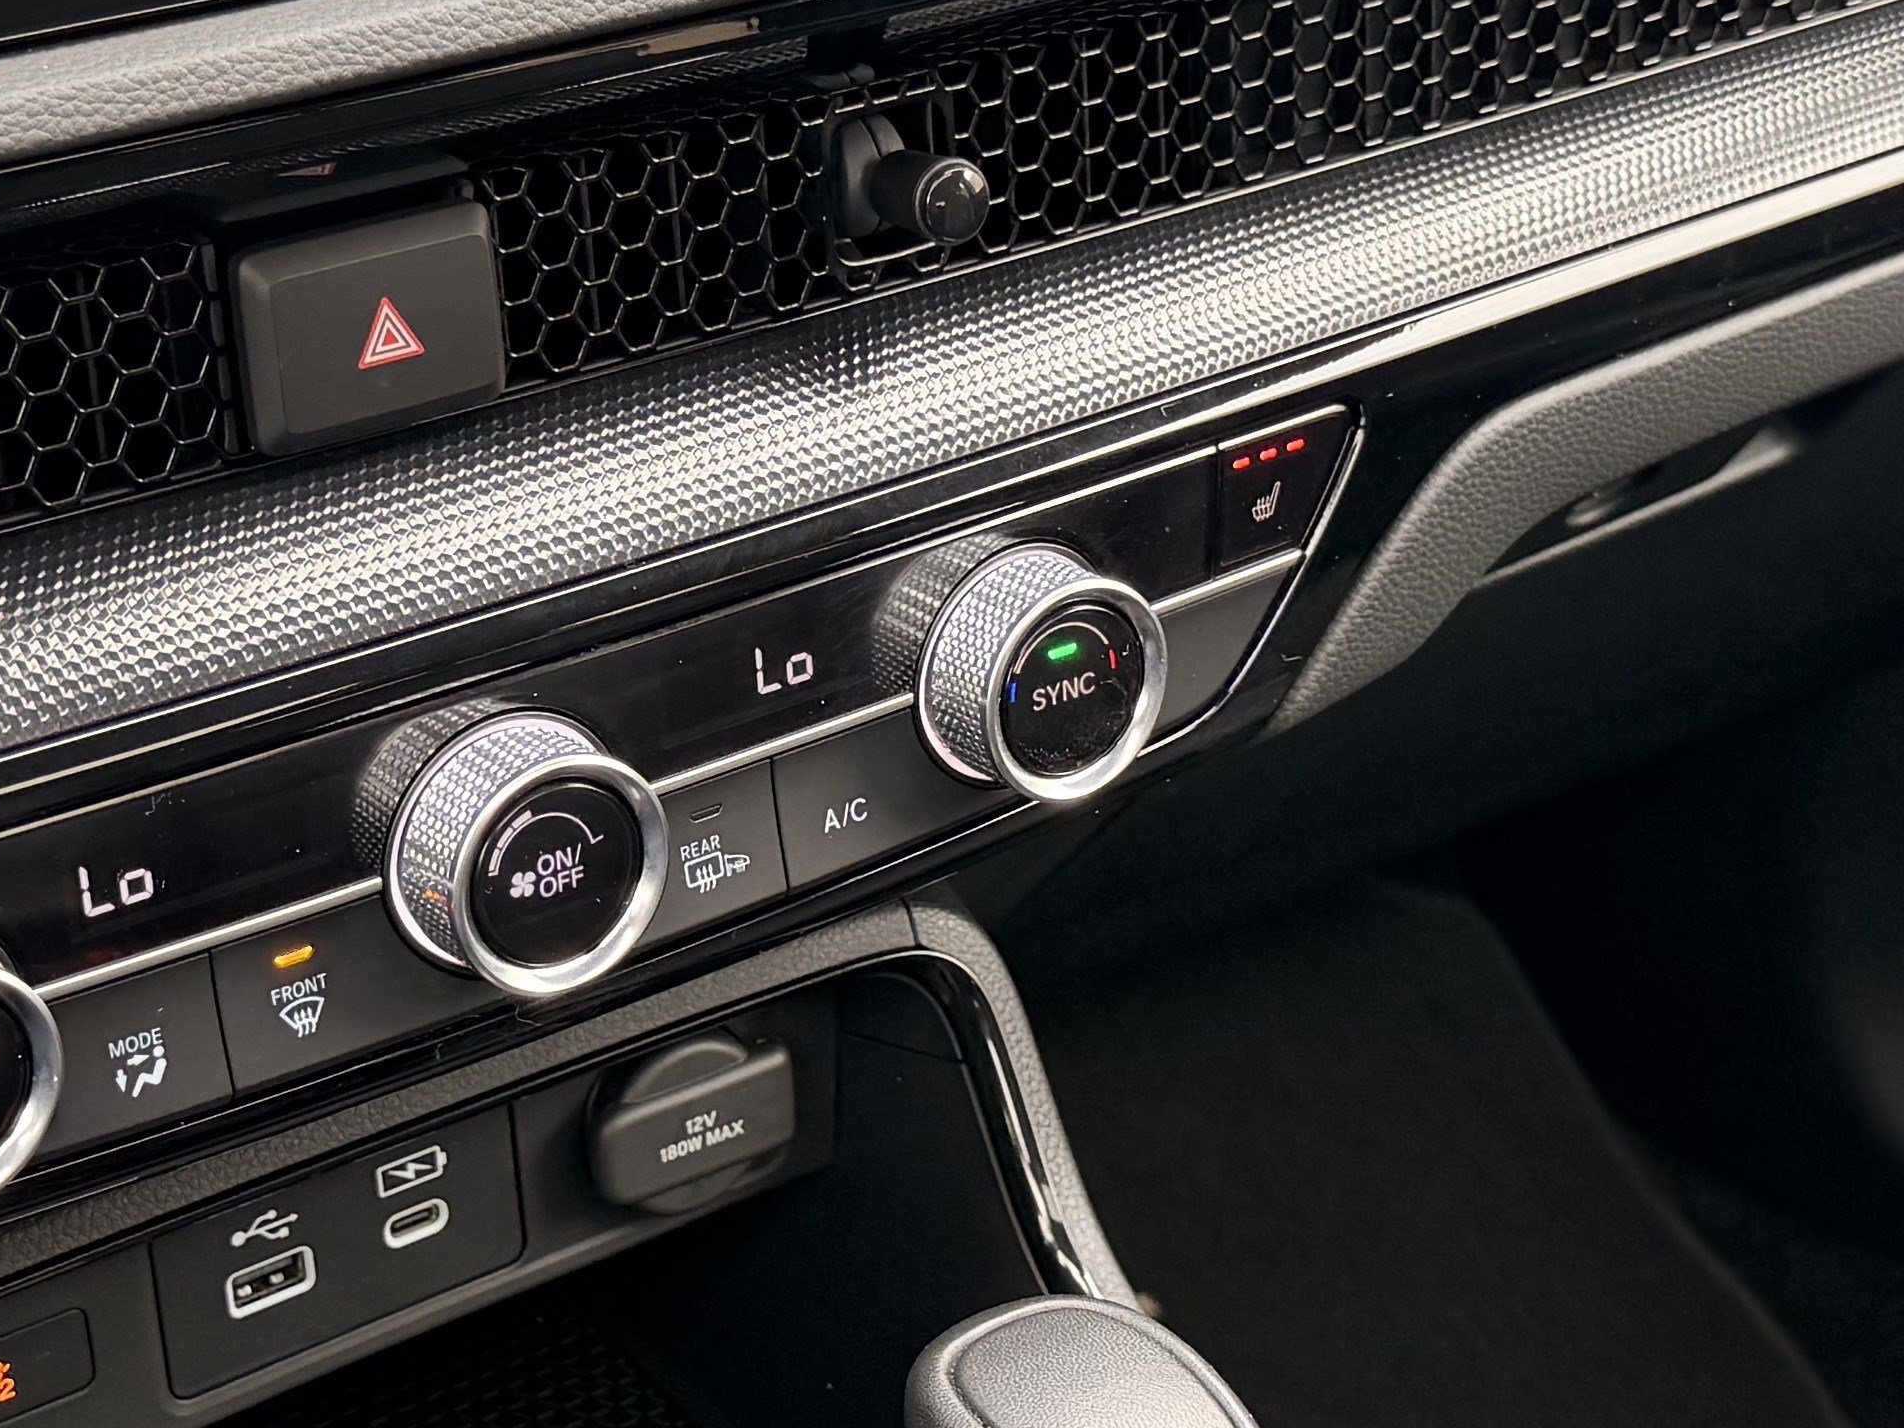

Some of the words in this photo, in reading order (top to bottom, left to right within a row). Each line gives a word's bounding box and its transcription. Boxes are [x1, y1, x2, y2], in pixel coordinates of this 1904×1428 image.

[755, 646, 814, 695] Lo
[1030, 672, 1096, 712] SYNC
[823, 797, 869, 833] A/C
[537, 843, 582, 874] ON/
[679, 834, 722, 861] REAR
[76, 867, 154, 917] Lo
[538, 869, 584, 898] OFF
[270, 973, 329, 1007] FRONT
[107, 1026, 164, 1061] MODE
[685, 1109, 717, 1135] 12V
[658, 1128, 701, 1164] 180W
[697, 1119, 745, 1153] MAX
